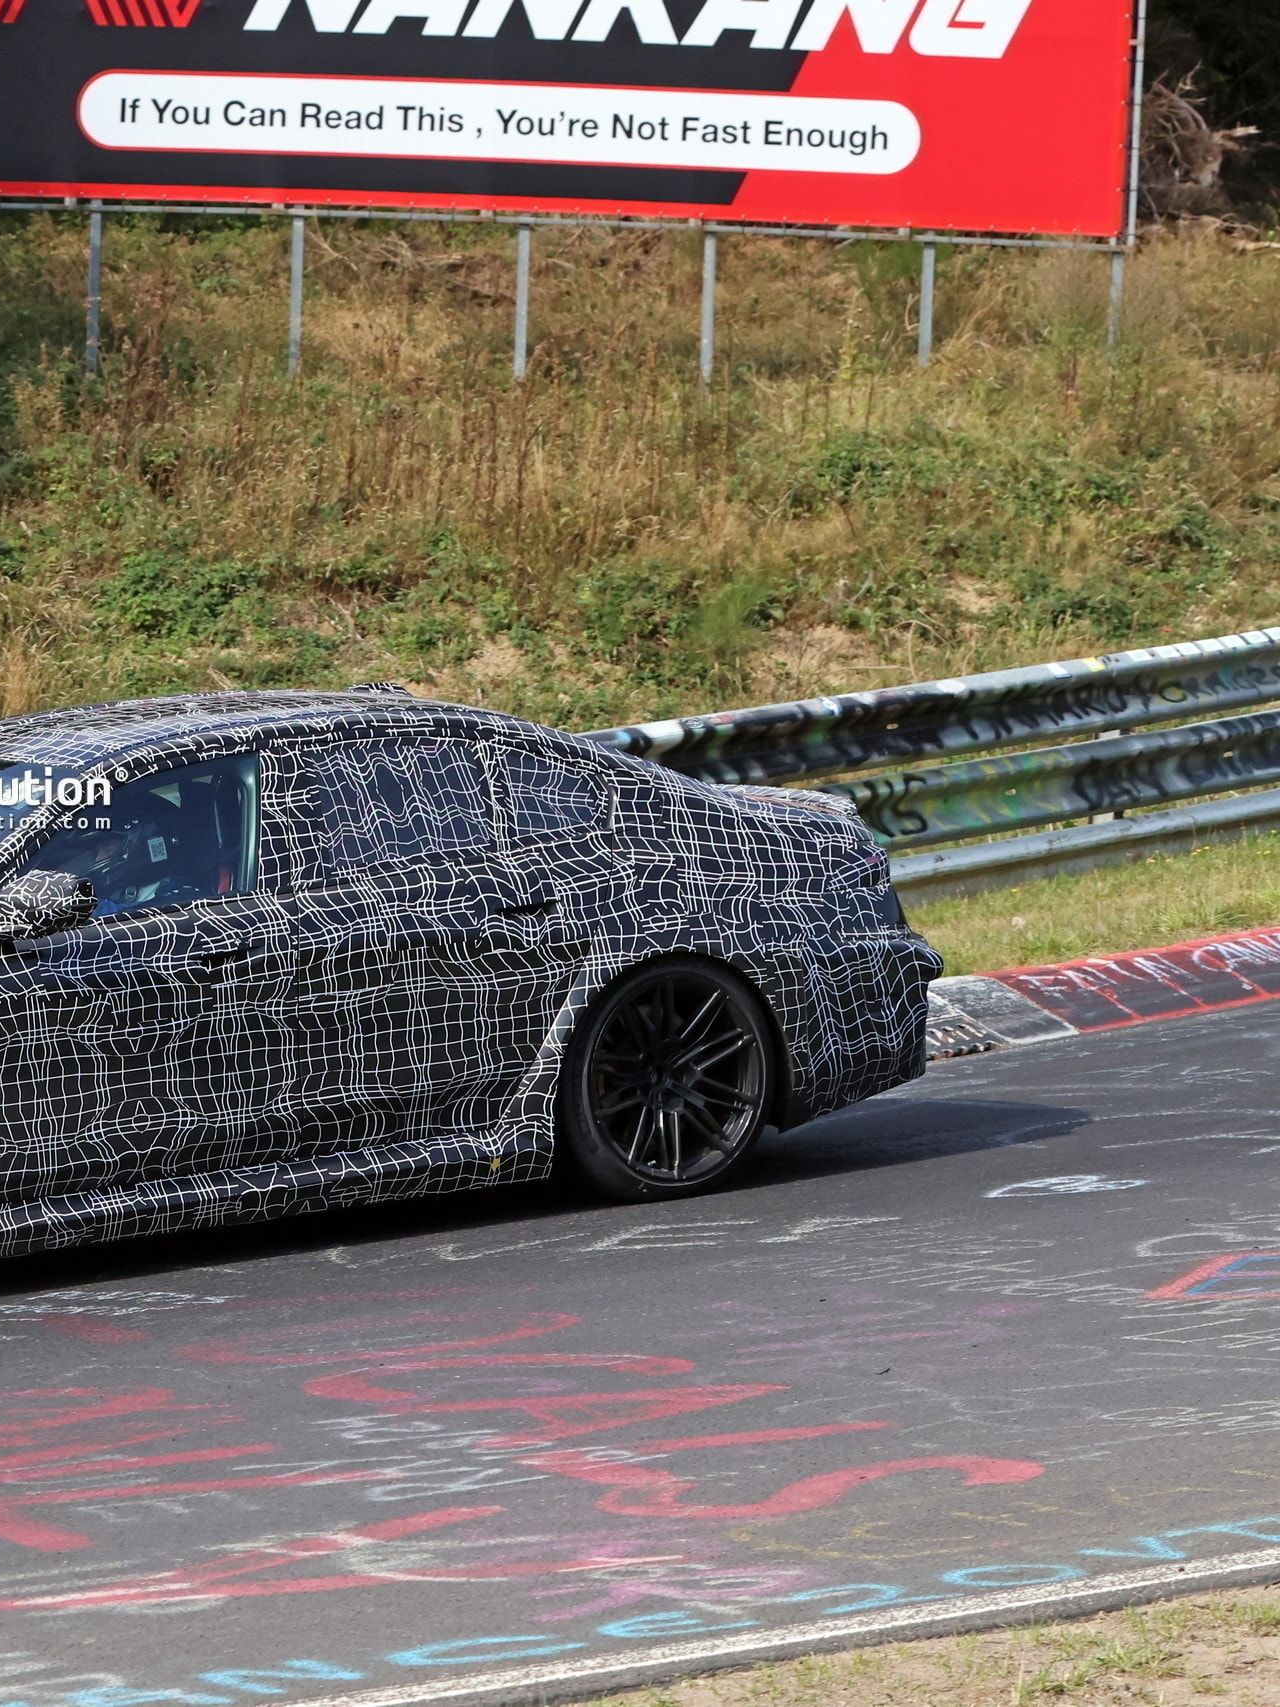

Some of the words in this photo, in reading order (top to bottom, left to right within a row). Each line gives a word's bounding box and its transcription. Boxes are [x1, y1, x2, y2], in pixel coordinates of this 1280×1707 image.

[119, 97, 140, 123] If
[150, 98, 211, 126] You
[222, 99, 288, 128] Can
[299, 102, 385, 131] Read
[396, 105, 465, 133] This
[496, 109, 599, 138] You're
[611, 113, 669, 141] Not
[680, 116, 751, 145] Fast
[763, 120, 889, 155] Enough
